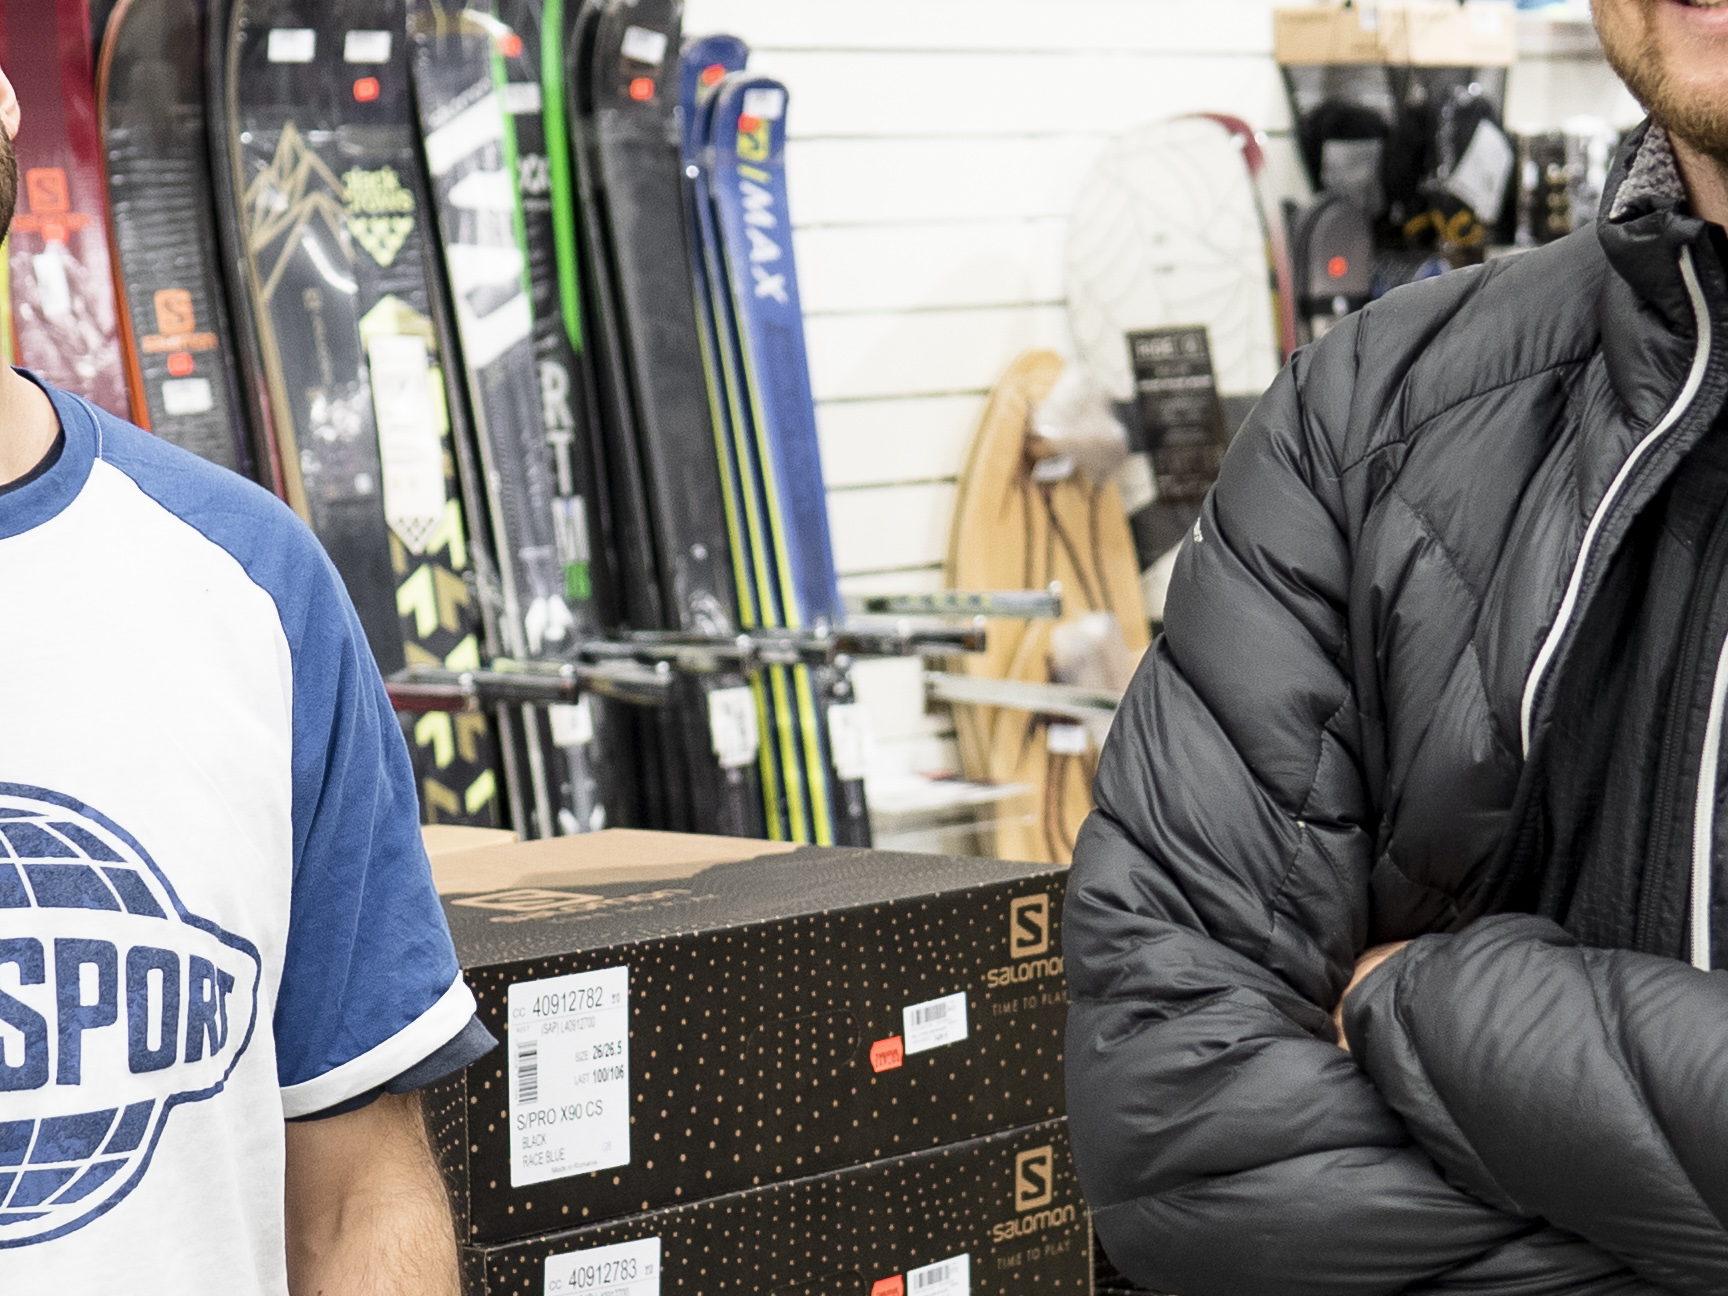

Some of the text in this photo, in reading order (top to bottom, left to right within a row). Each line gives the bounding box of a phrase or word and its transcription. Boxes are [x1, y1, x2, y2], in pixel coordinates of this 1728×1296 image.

[533, 986, 604, 1017] 40912782
[593, 1040, 622, 1059] 26/26.5
[593, 1065, 624, 1084] 100/106
[517, 1100, 603, 1131] S/PRO X90 CS
[522, 1133, 547, 1149] BLACK
[546, 1148, 565, 1164] BLUE
[569, 1258, 637, 1289] 40912783
